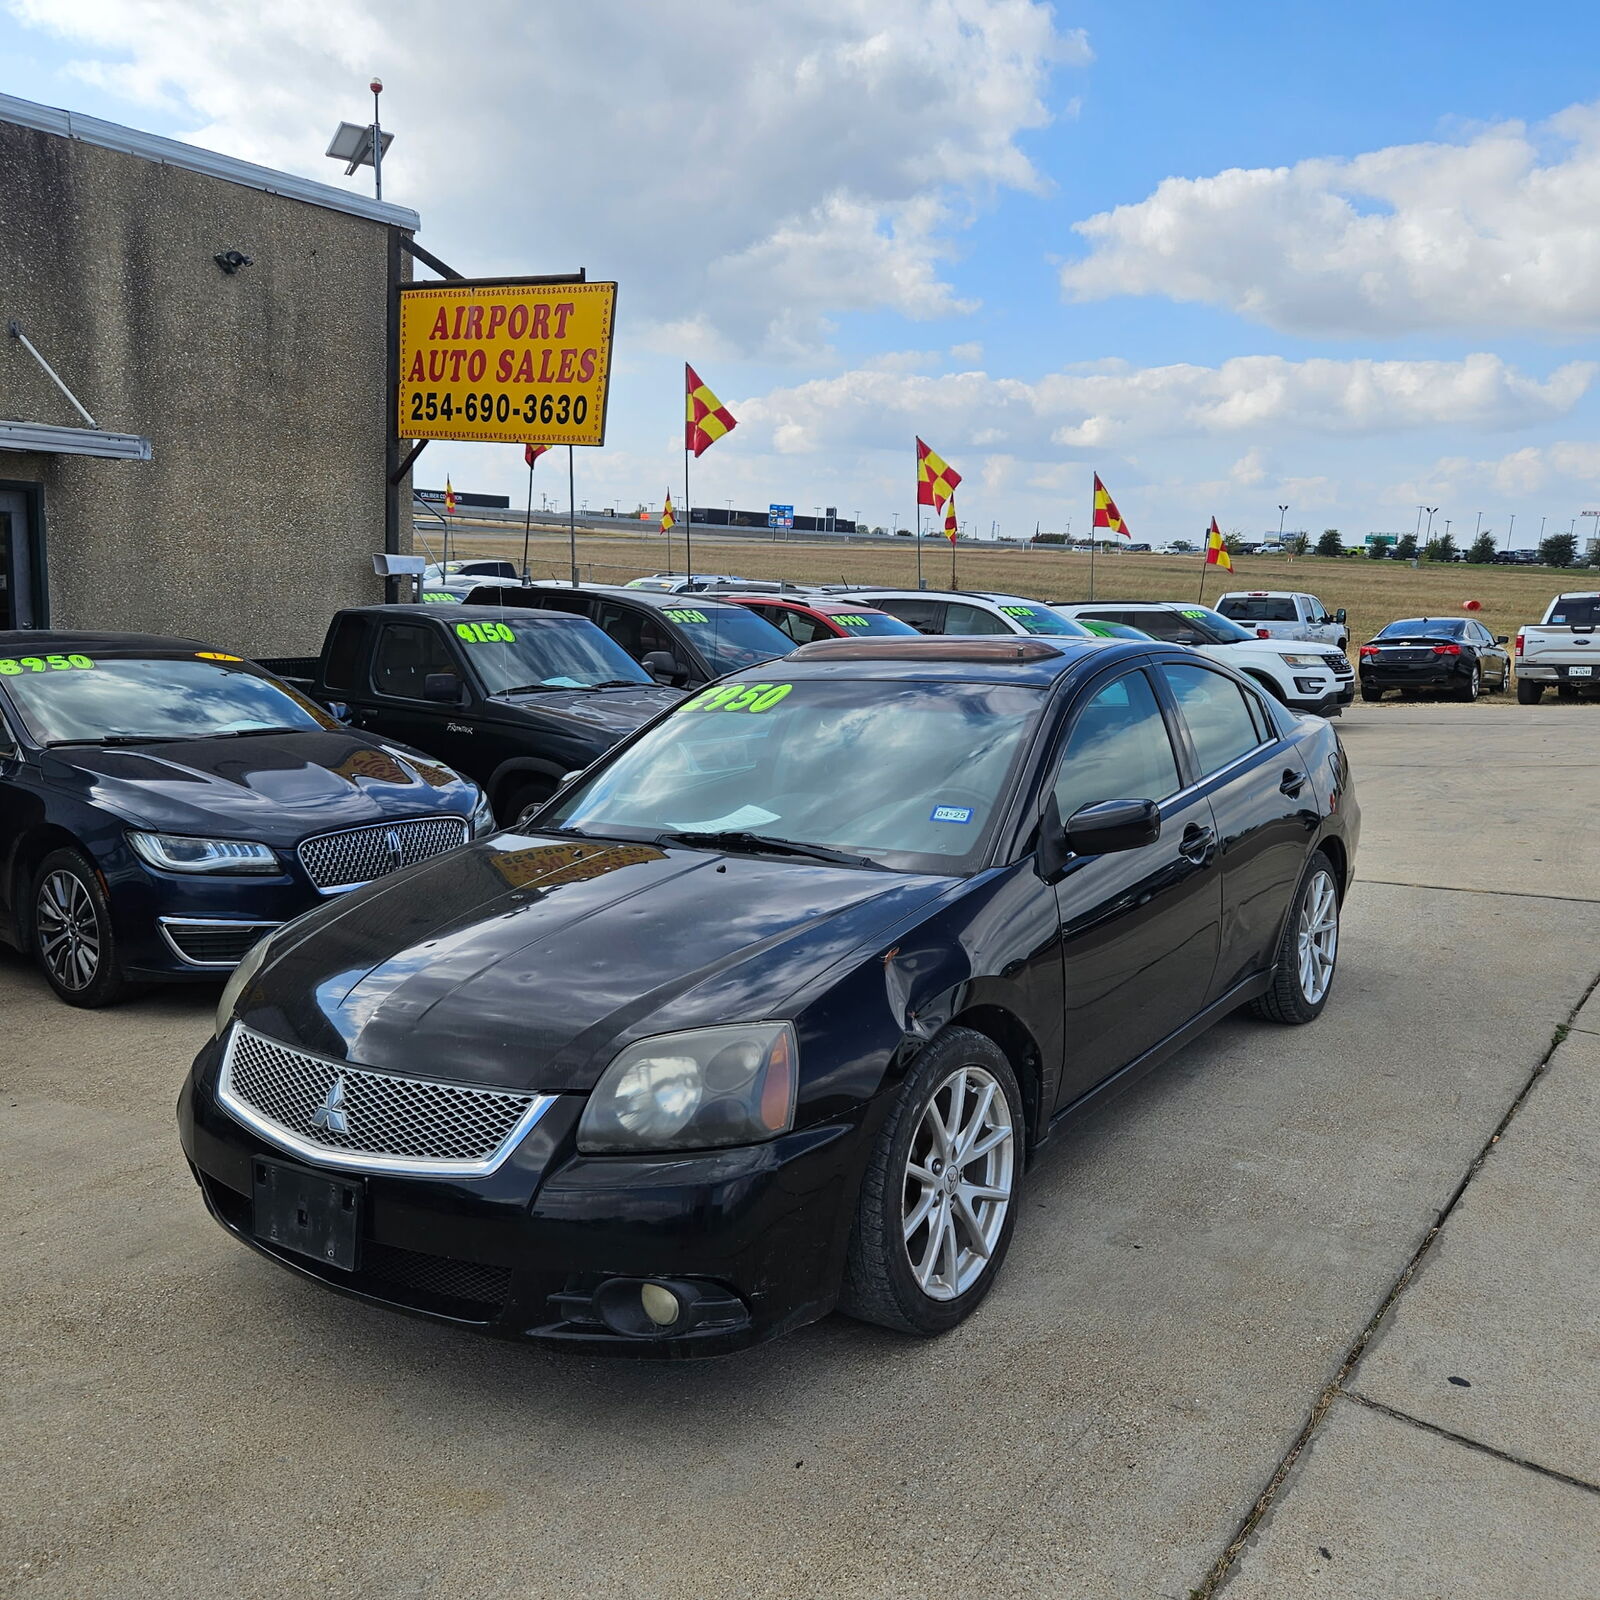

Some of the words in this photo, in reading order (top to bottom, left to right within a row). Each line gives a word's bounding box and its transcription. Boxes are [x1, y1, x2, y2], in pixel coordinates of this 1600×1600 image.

[429, 302, 575, 340] AIRPORT
[408, 349, 487, 383] AUTO
[495, 348, 598, 383] SALES
[411, 392, 588, 425] 254-690-3630
[662, 609, 710, 624] 3950
[455, 622, 517, 644] 4150
[0, 654, 95, 676] 8950
[679, 683, 794, 713] 2950
